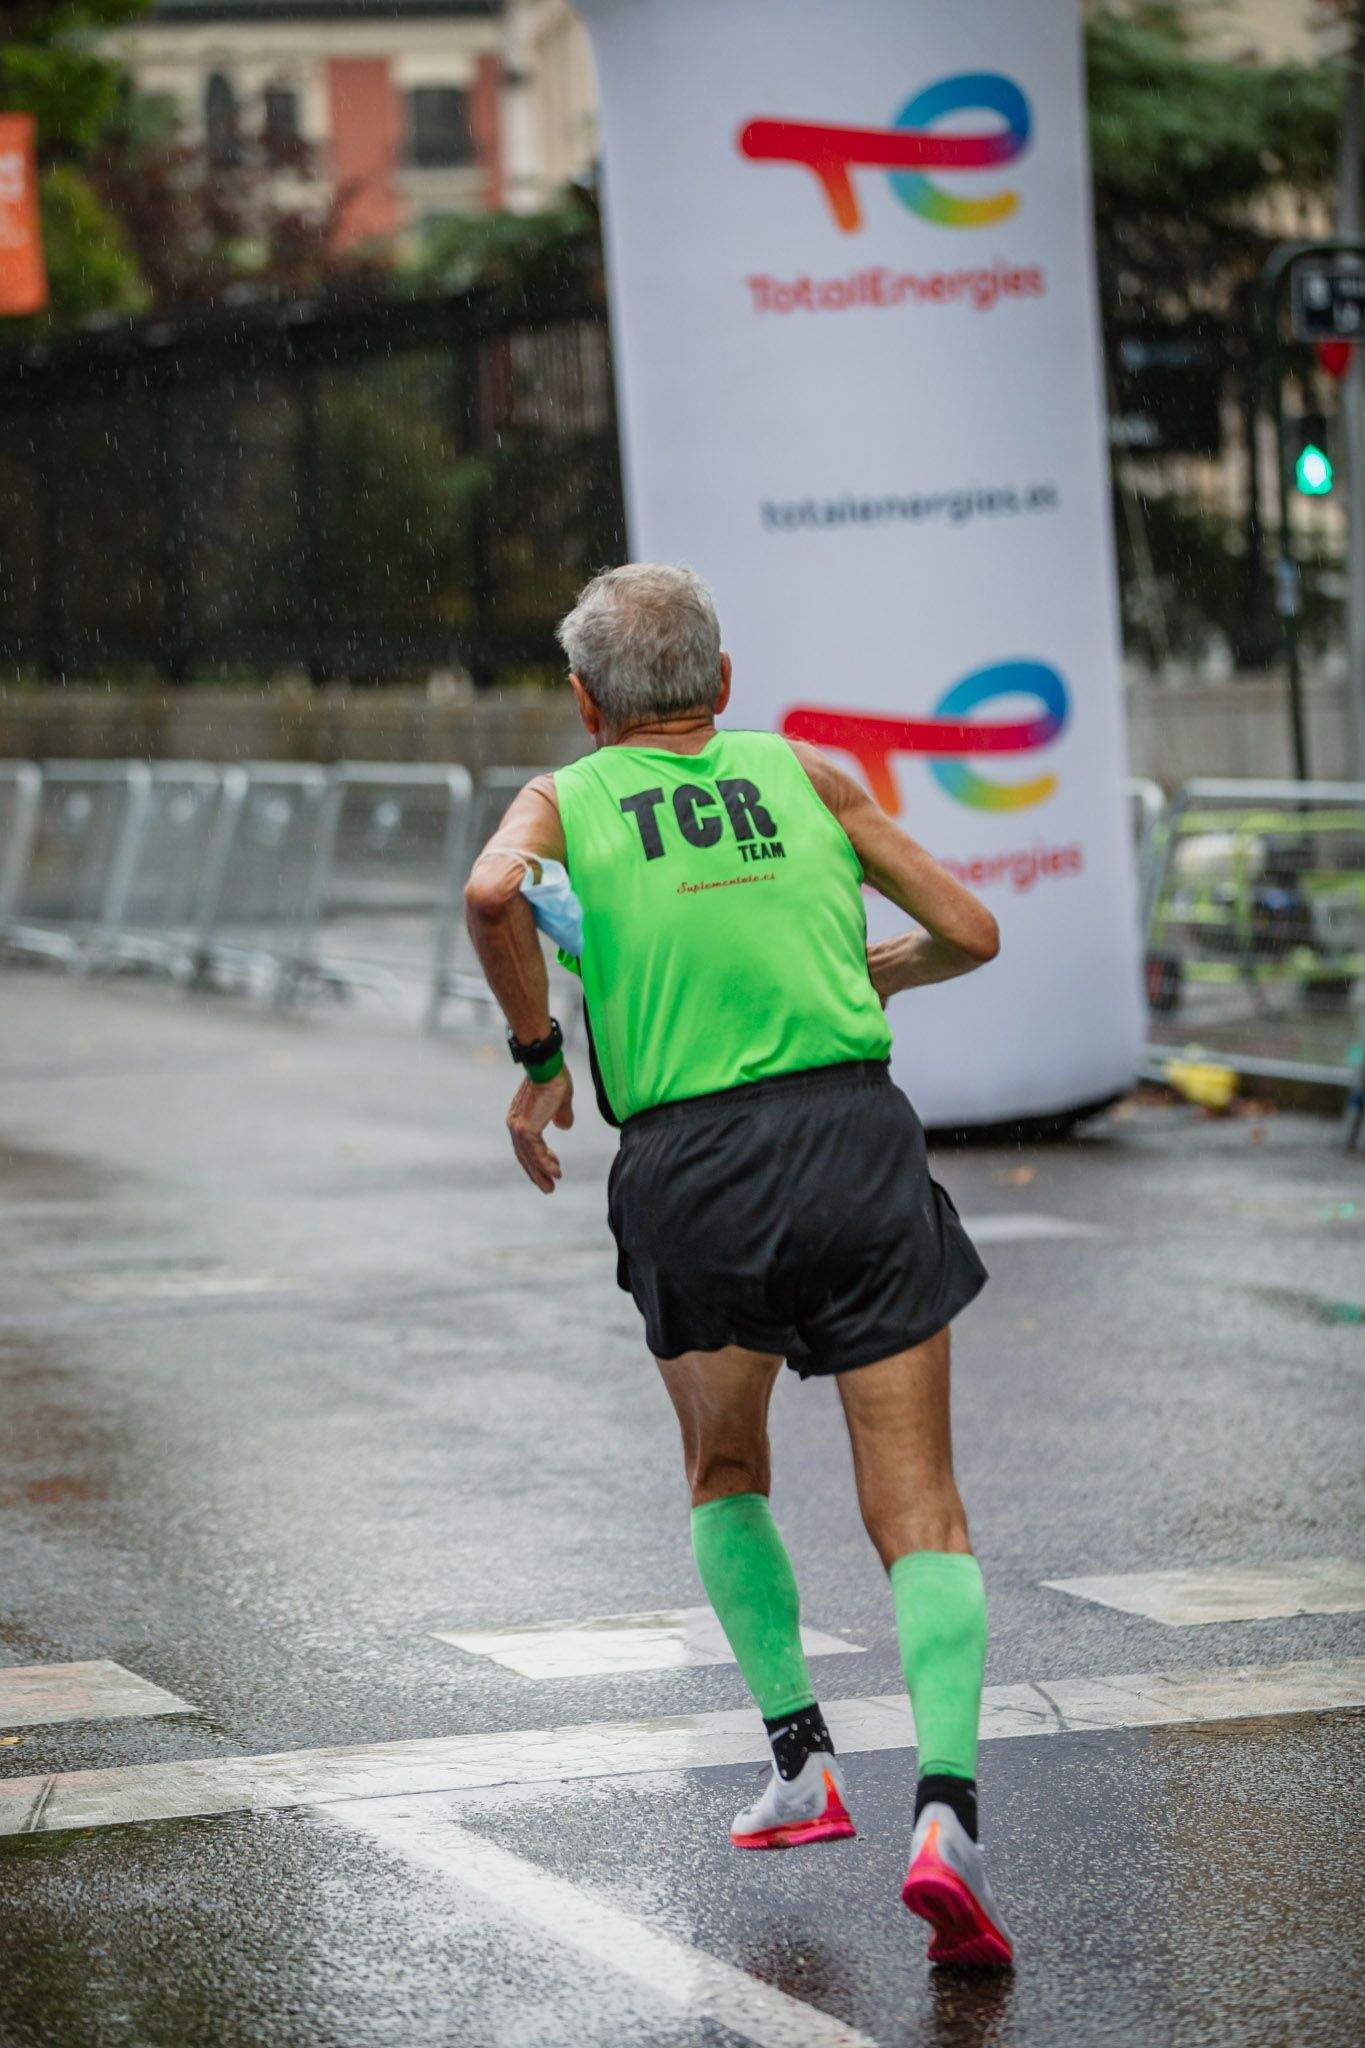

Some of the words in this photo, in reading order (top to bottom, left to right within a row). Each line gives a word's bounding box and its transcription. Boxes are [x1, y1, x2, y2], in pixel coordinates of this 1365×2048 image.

[620, 778, 778, 861] TCR
[737, 841, 786, 862] TEAM
[938, 840, 1085, 893] nergies
